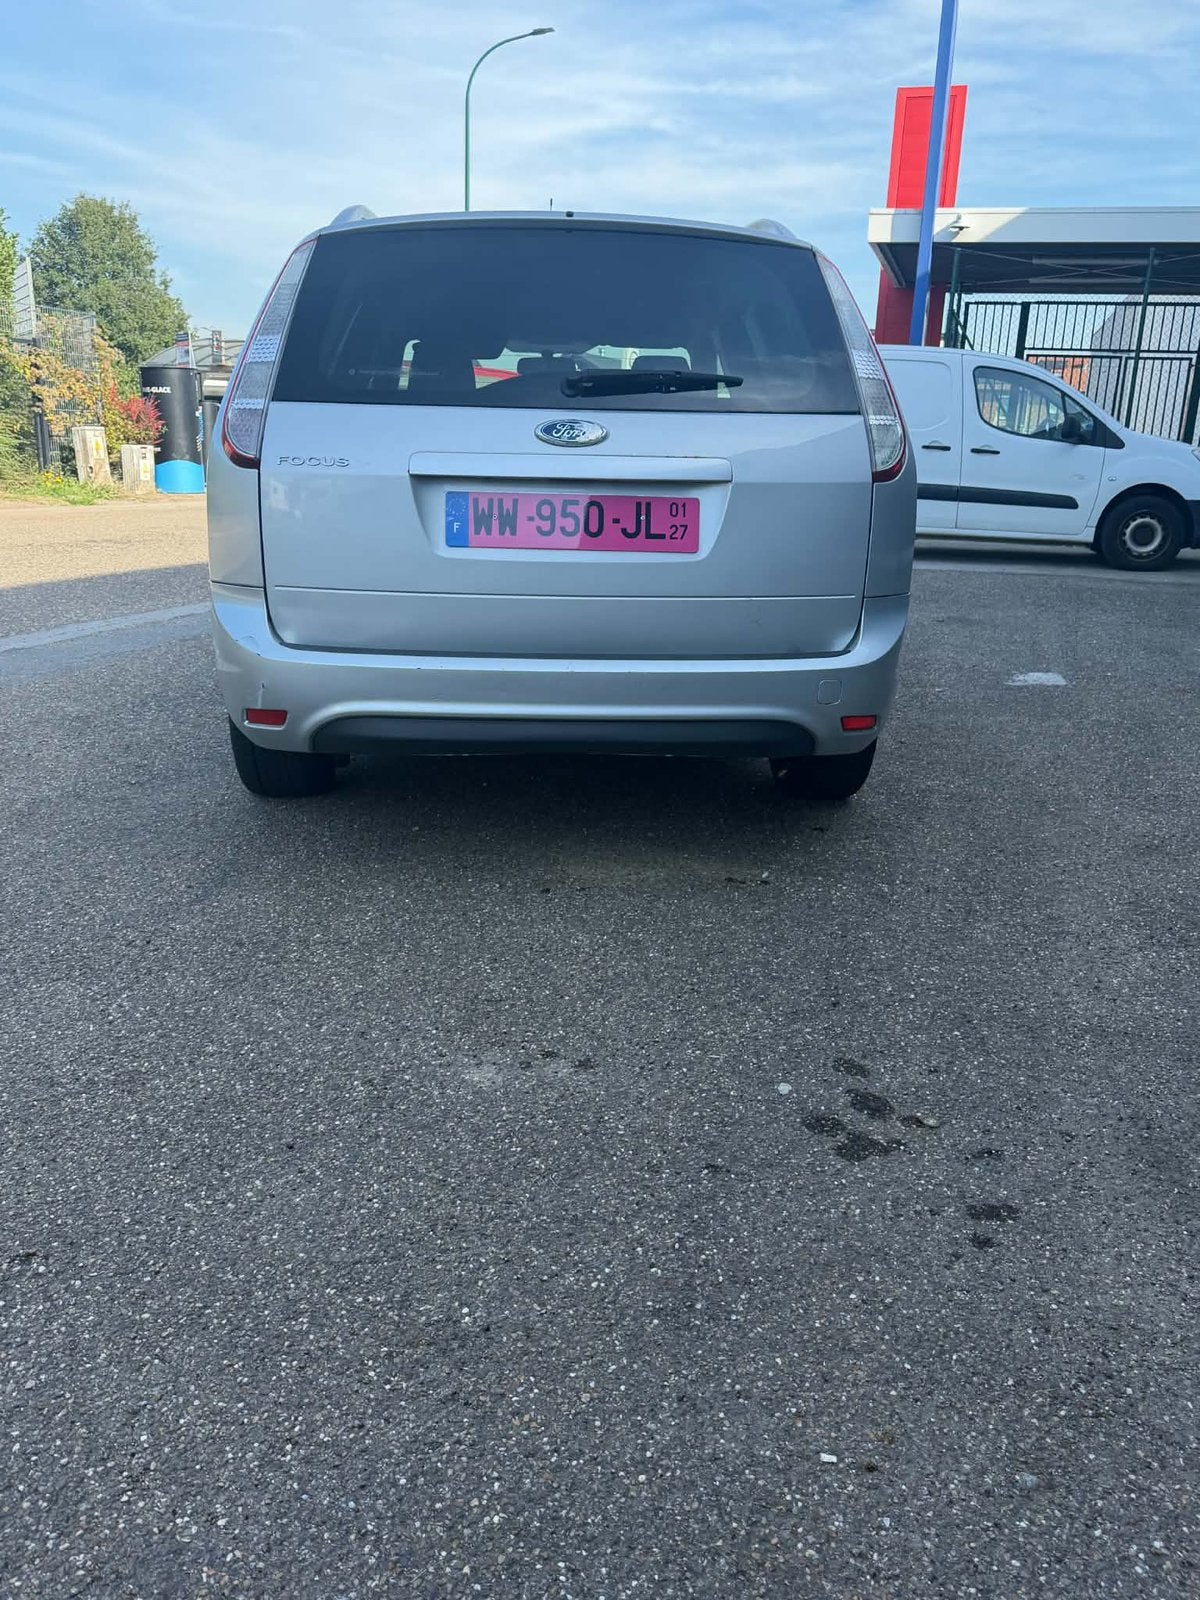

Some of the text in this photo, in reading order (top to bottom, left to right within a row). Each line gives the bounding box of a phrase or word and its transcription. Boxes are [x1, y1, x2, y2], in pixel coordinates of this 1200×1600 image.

[277, 456, 350, 467] FOCUS
[669, 501, 687, 518] 01
[453, 522, 461, 533] F
[669, 524, 688, 540] 27
